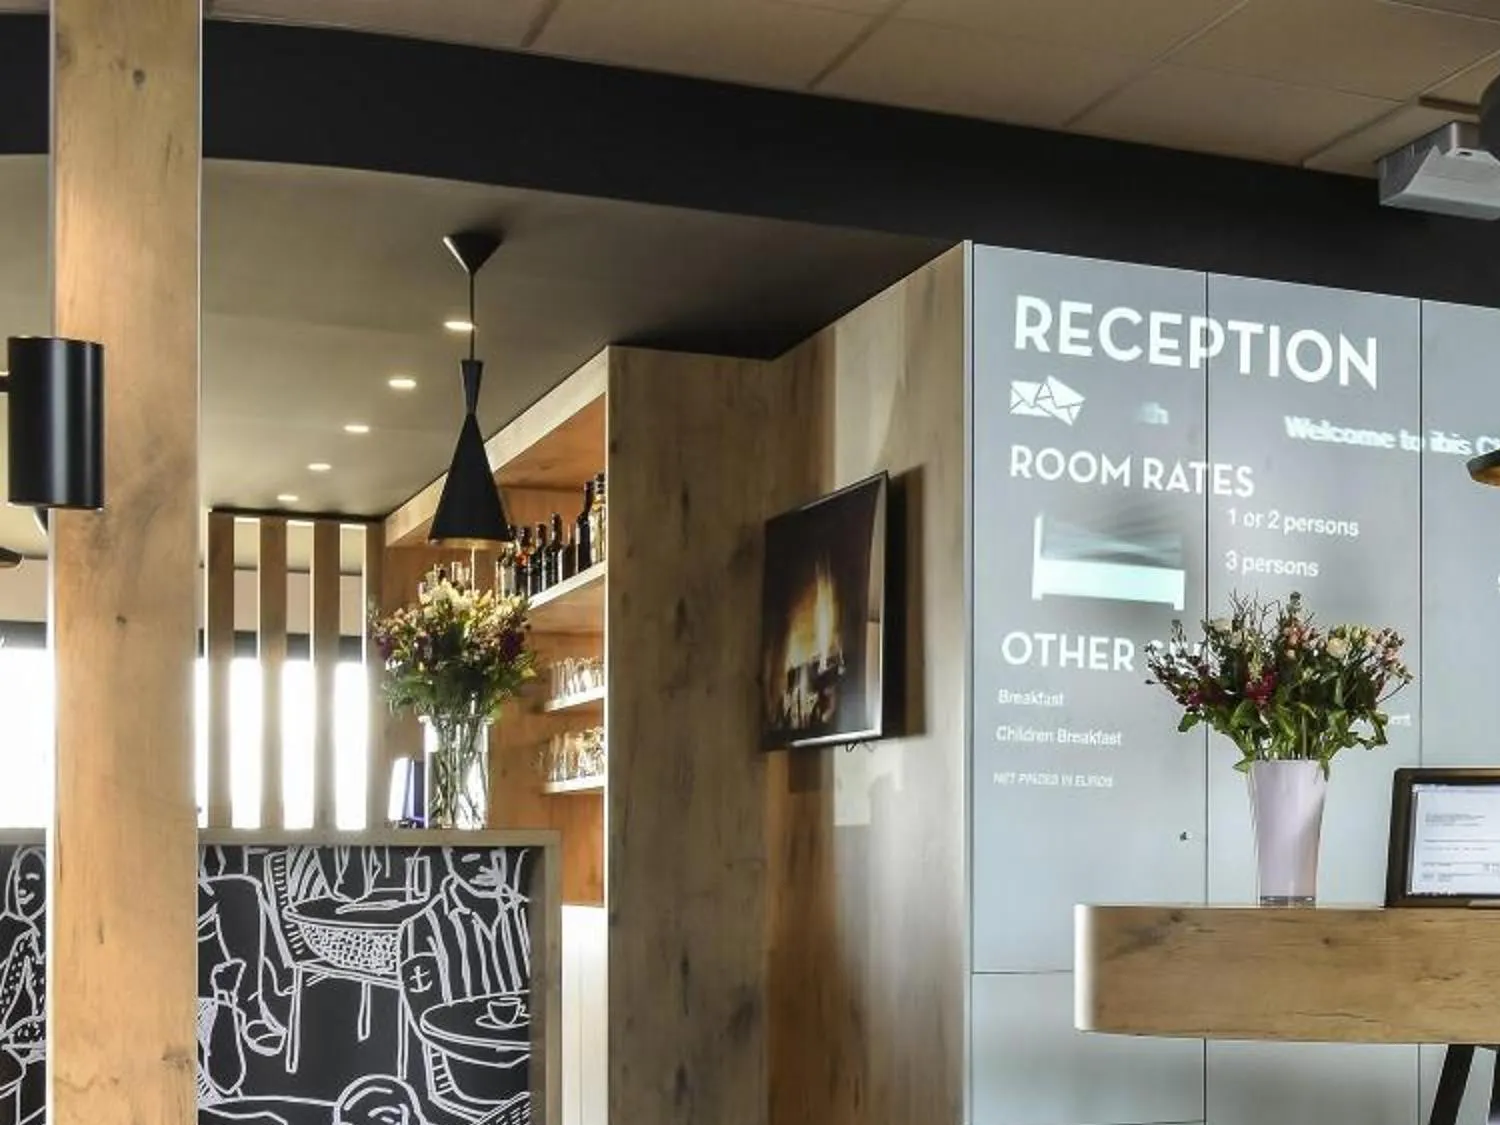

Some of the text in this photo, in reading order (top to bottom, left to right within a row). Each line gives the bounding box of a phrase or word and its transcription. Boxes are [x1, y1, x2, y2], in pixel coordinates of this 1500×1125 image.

[1014, 295, 1377, 391] RECEPTION
[1284, 415, 1396, 449] Welcome
[1400, 429, 1426, 452] to
[1010, 446, 1254, 498] ROOM RATES
[1227, 507, 1360, 537] 1 or 2 persons
[1225, 550, 1319, 577] 3 persons
[1001, 631, 1136, 672] OTHER
[998, 689, 1064, 706] Breakfast
[996, 725, 1123, 746] Children Breakfast
